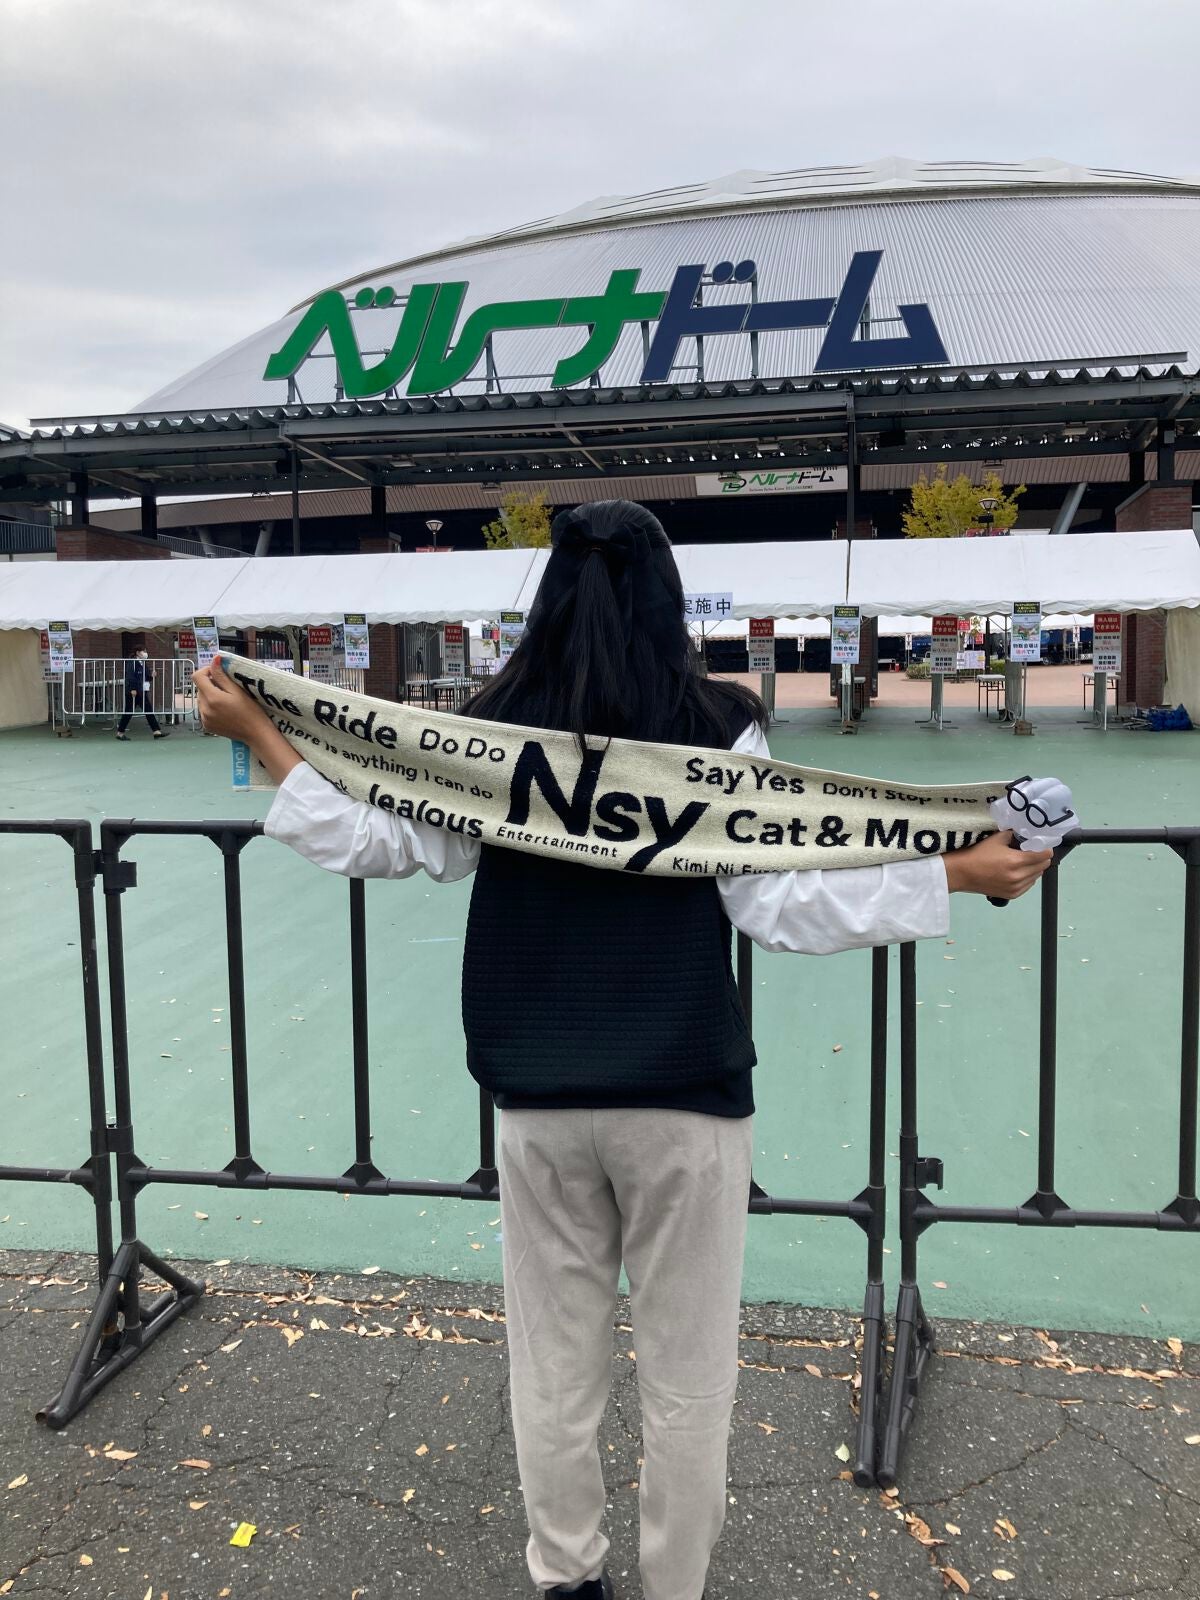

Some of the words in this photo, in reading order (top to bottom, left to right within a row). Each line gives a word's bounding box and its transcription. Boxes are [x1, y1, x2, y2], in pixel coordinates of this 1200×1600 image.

[263, 249, 950, 399] ベルーナドーム
[749, 471, 834, 486] ベルーナドーム
[234, 672, 303, 717] The
[314, 698, 398, 750] Ride
[277, 719, 321, 747] there
[324, 740, 338, 755] is
[342, 749, 418, 782] anything
[434, 774, 464, 793] can
[470, 784, 493, 800] do
[686, 757, 744, 795] Say
[750, 764, 805, 795] Yes
[364, 783, 484, 839] Jealous
[823, 782, 877, 800] Don't
[885, 789, 931, 805] Stop
[497, 826, 618, 858] Entertainment
[726, 810, 807, 848] Cat
[815, 815, 852, 848] &
[672, 856, 708, 874] Kimi
[715, 862, 734, 875] Ni
